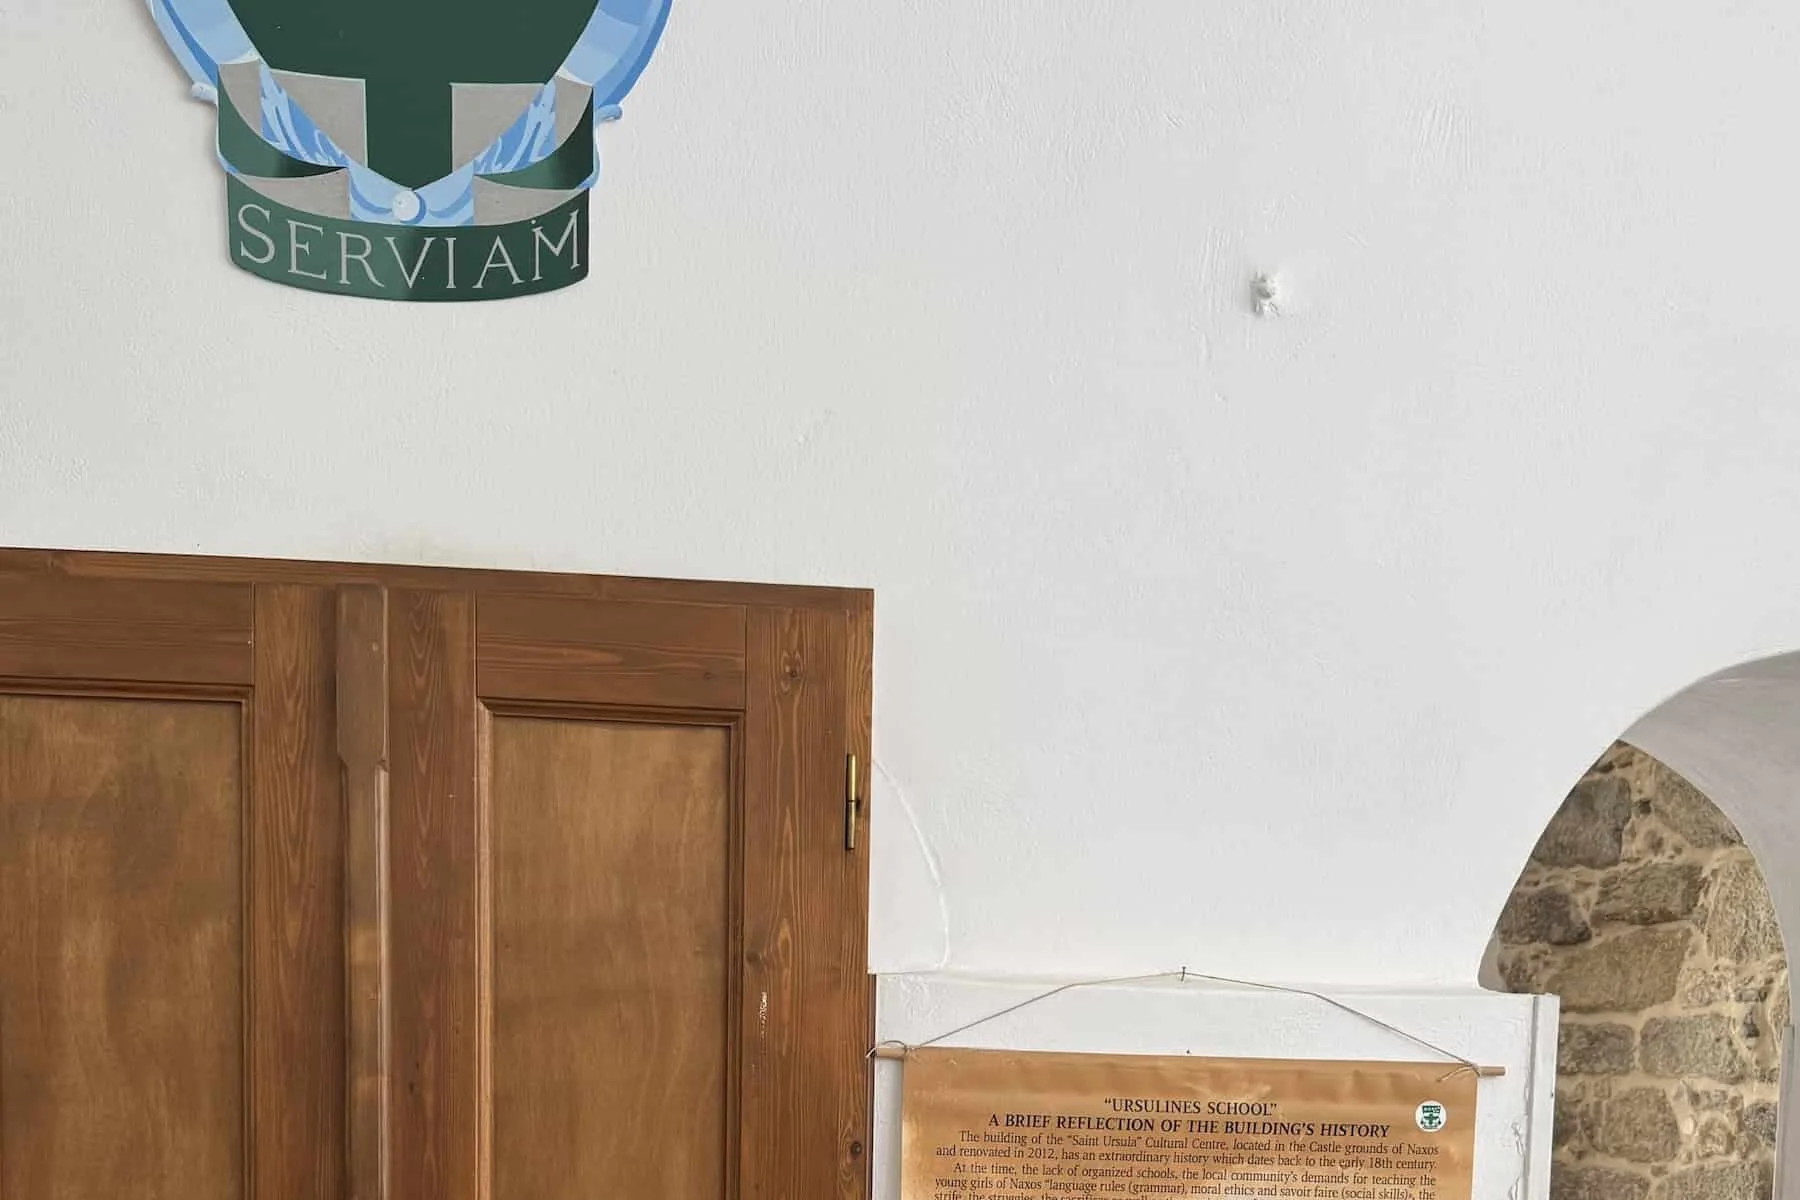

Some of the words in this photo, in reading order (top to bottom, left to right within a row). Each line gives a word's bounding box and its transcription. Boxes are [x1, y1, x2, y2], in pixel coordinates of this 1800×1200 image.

[237, 204, 582, 289] SERVIAM
[988, 1114, 999, 1127] A
[1005, 1113, 1051, 1128] BRIEF
[1056, 1115, 1154, 1131] REFLECTION
[1160, 1119, 1182, 1132] OF
[1187, 1120, 1218, 1134] THE
[1319, 1123, 1390, 1138] HISTORY
[960, 1130, 980, 1142] The
[983, 1131, 1027, 1146] building
[1031, 1132, 1042, 1144] of
[1046, 1133, 1063, 1145] the
[1145, 1136, 1188, 1148] Cultural
[1191, 1137, 1229, 1151] Centre,
[1232, 1138, 1270, 1151] located
[1274, 1139, 1285, 1151] in
[1289, 1140, 1306, 1152] the
[1308, 1140, 1341, 1152] Castle
[1344, 1141, 1388, 1156] grounds
[1391, 1142, 1402, 1154] of
[1407, 1142, 1438, 1155] Naxos
[936, 1144, 956, 1156] and
[959, 1144, 1010, 1158] renovated
[1013, 1146, 1024, 1158] in
[1027, 1146, 1058, 1160] 2012,
[1061, 1148, 1079, 1160] has
[1082, 1151, 1095, 1160] an
[1098, 1149, 1170, 1165] extraordinary
[1173, 1151, 1209, 1166] history
[1212, 1152, 1244, 1164] which
[1247, 1153, 1274, 1165] dates
[1277, 1154, 1301, 1166] back
[1305, 1156, 1316, 1166] to
[1319, 1155, 1336, 1167] the
[1338, 1155, 1365, 1170] early
[1369, 1156, 1392, 1168] 18th
[1395, 1158, 1436, 1172] century.
